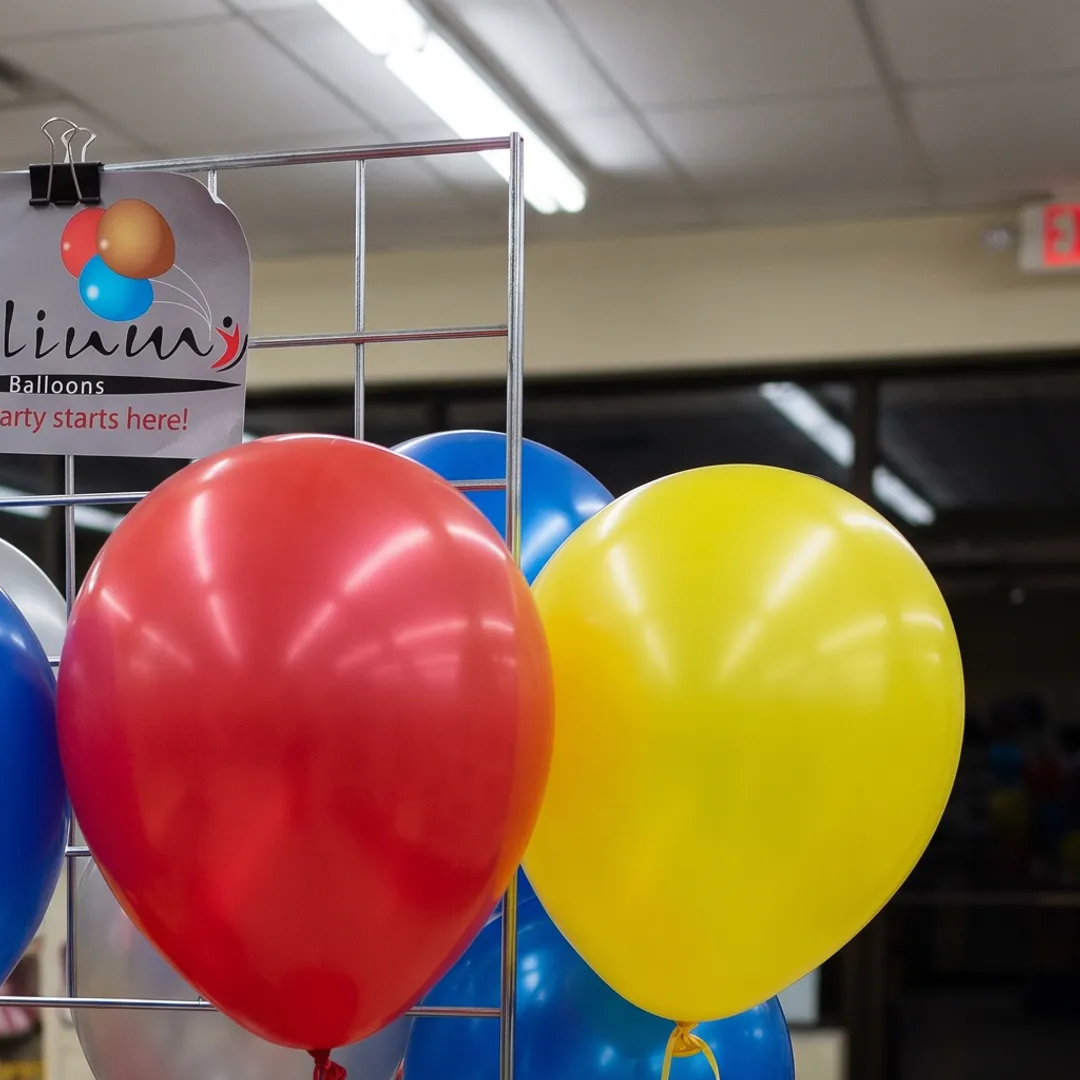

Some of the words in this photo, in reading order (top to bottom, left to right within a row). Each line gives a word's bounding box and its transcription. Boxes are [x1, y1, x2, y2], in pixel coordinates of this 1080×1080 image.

[9, 375, 105, 395] Balloons
[52, 408, 119, 429] starts
[126, 406, 189, 431] here!
